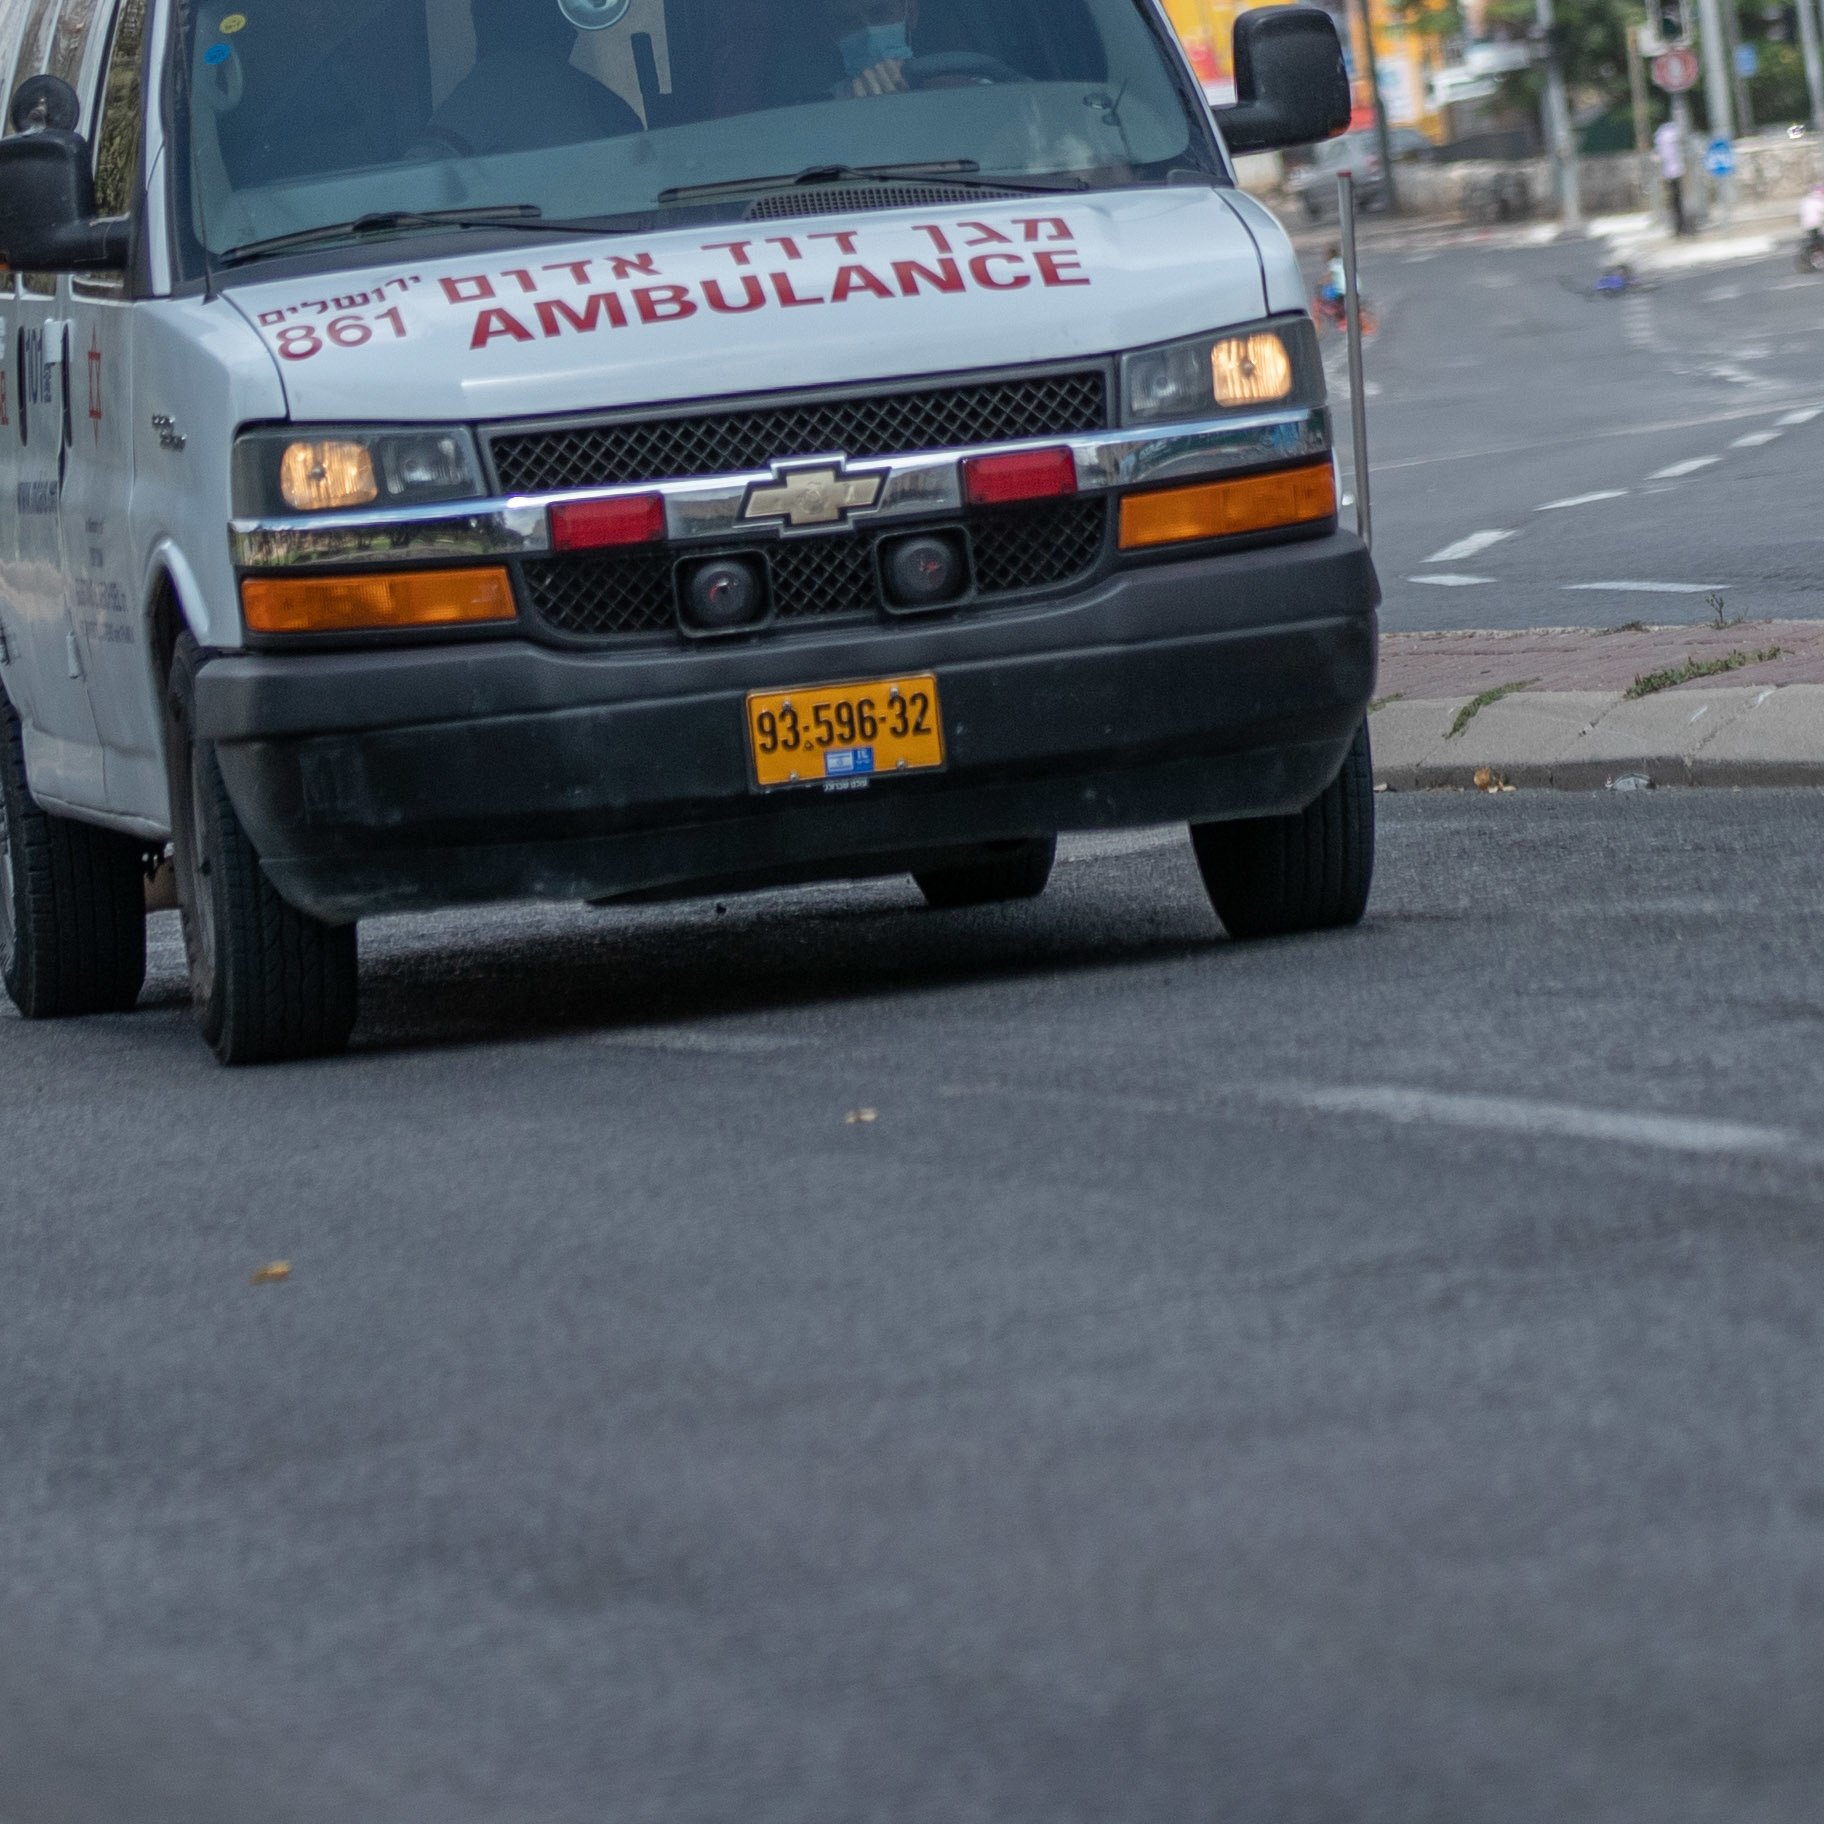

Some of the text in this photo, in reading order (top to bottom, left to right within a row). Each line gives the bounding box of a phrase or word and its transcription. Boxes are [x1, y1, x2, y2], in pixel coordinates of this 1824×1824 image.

[438, 217, 1074, 304] מגן דוד אדום
[257, 275, 421, 327] ירושלים
[469, 249, 1092, 351] AMBULANCE
[276, 306, 407, 362] 861
[756, 692, 932, 754] 93-596-32
